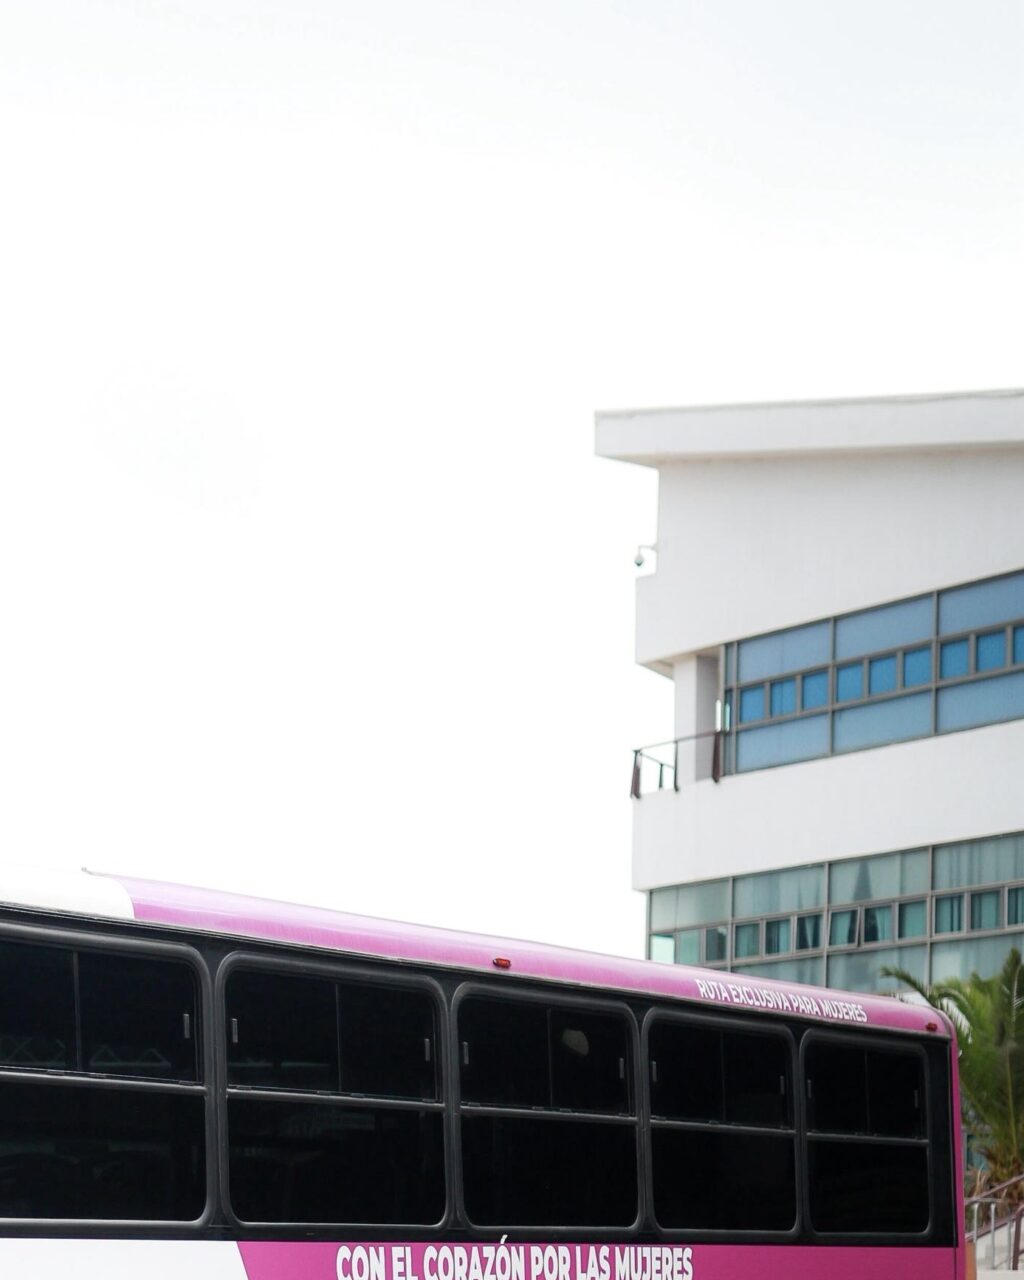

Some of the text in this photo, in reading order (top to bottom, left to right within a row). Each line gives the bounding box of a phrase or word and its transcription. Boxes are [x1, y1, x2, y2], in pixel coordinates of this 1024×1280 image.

[695, 978, 868, 1022] RUTA EXCLUSIVA PARA MUJERES
